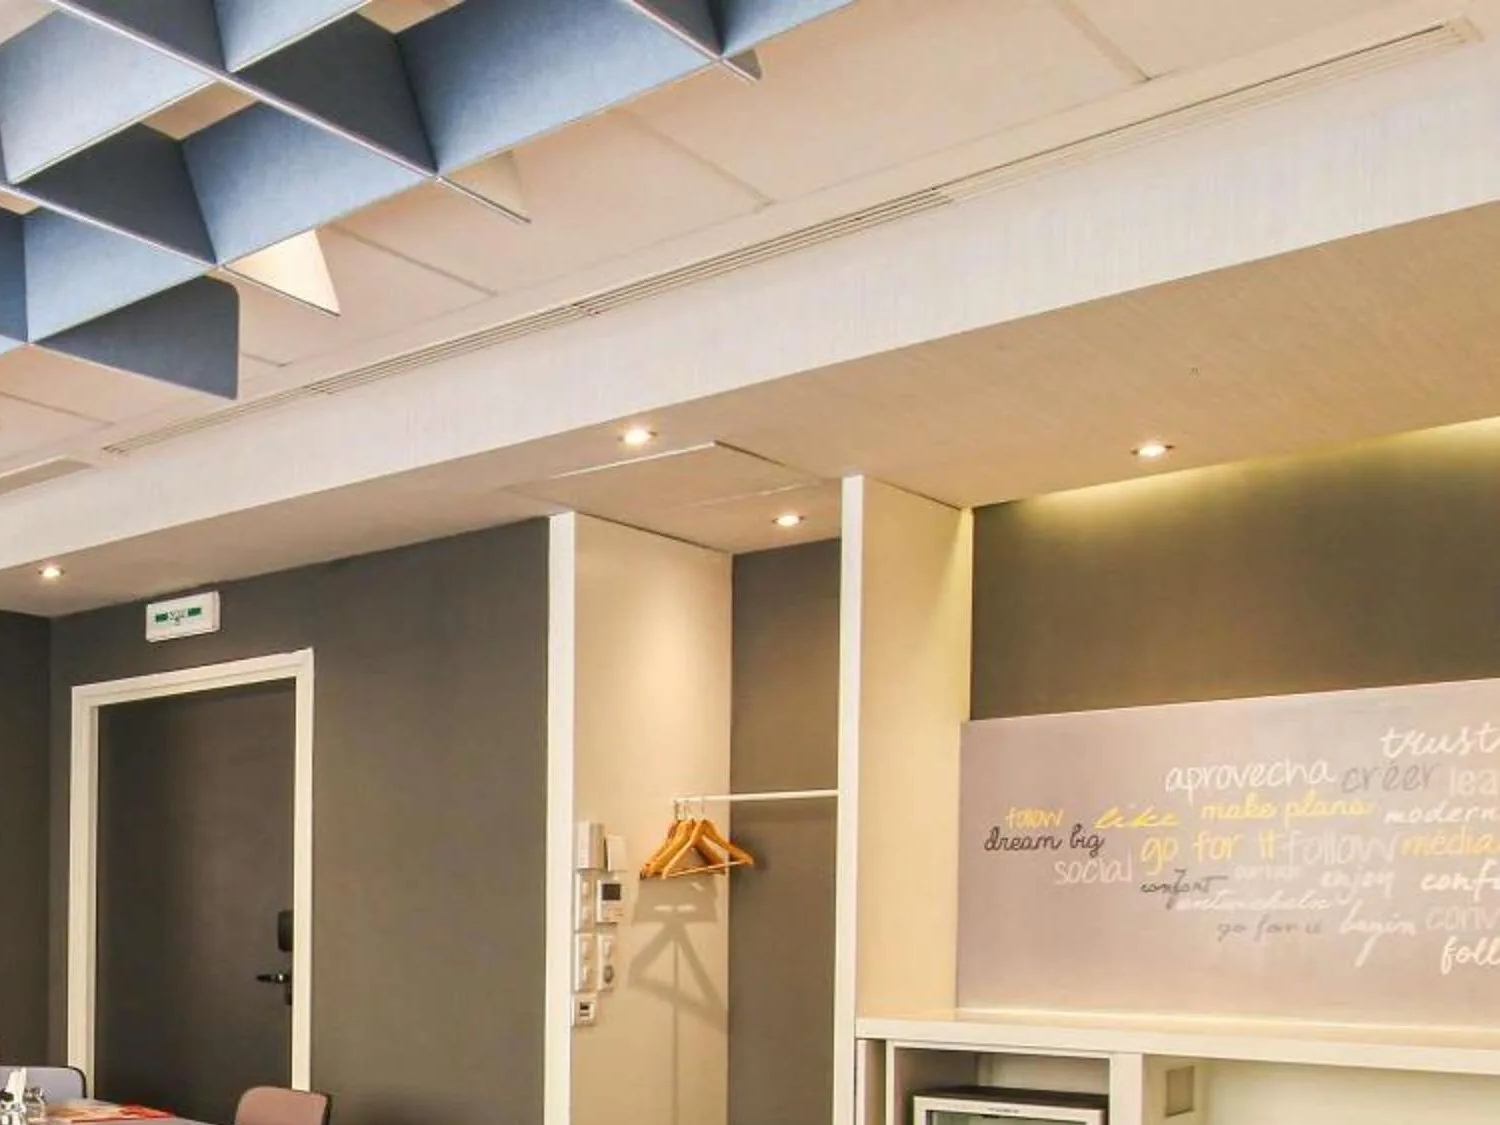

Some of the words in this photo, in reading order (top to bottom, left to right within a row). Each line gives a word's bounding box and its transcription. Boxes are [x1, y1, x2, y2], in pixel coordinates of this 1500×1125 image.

[1164, 757, 1336, 806] aprovecha
[984, 826, 1063, 851] dream
[1069, 823, 1105, 858] big
[1140, 835, 1178, 876] go
[1193, 831, 1243, 864] for
[1282, 829, 1400, 866] follow
[1054, 846, 1133, 886] social
